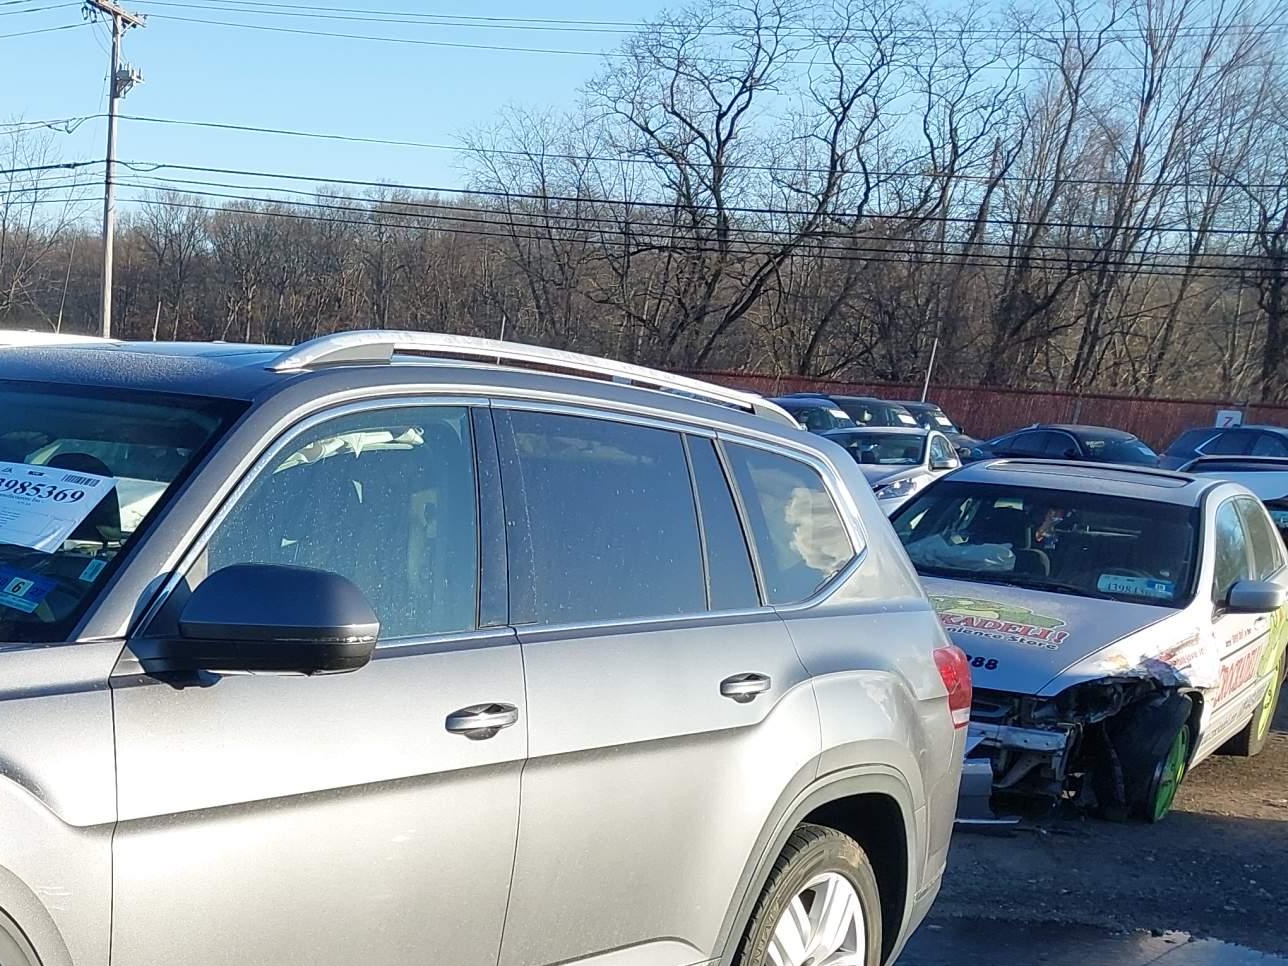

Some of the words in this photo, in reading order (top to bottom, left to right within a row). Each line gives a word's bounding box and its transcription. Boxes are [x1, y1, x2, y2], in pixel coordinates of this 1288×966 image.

[938, 613, 1069, 644] KADELI!
[946, 626, 1002, 640] nience
[1008, 634, 1059, 651] Store
